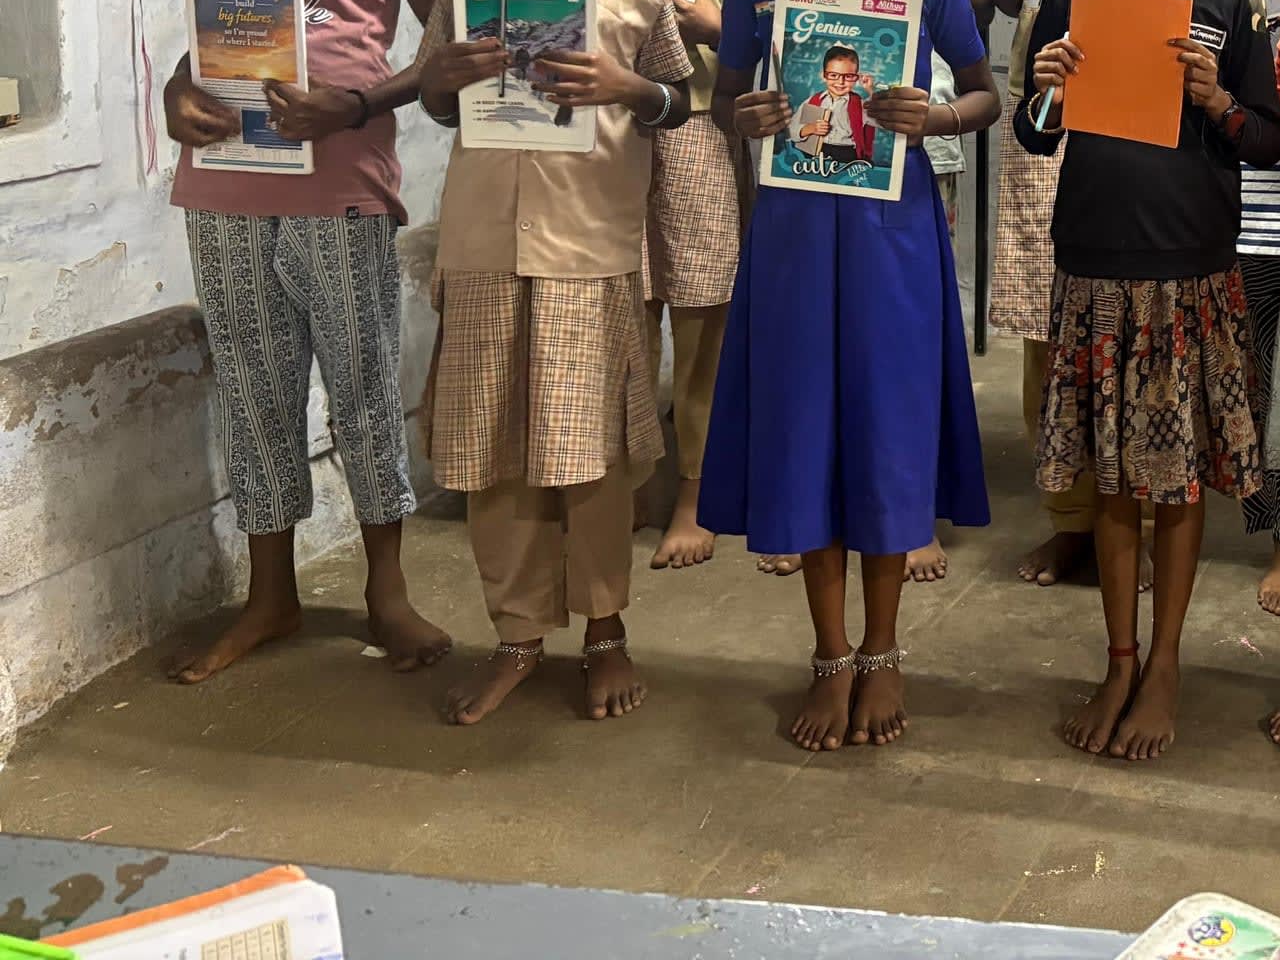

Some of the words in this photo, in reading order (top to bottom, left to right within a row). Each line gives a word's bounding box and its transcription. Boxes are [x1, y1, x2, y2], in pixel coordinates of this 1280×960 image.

[235, 0, 255, 8] build
[218, 7, 234, 27] big
[792, 10, 862, 44] Genius
[793, 152, 846, 177] cute
